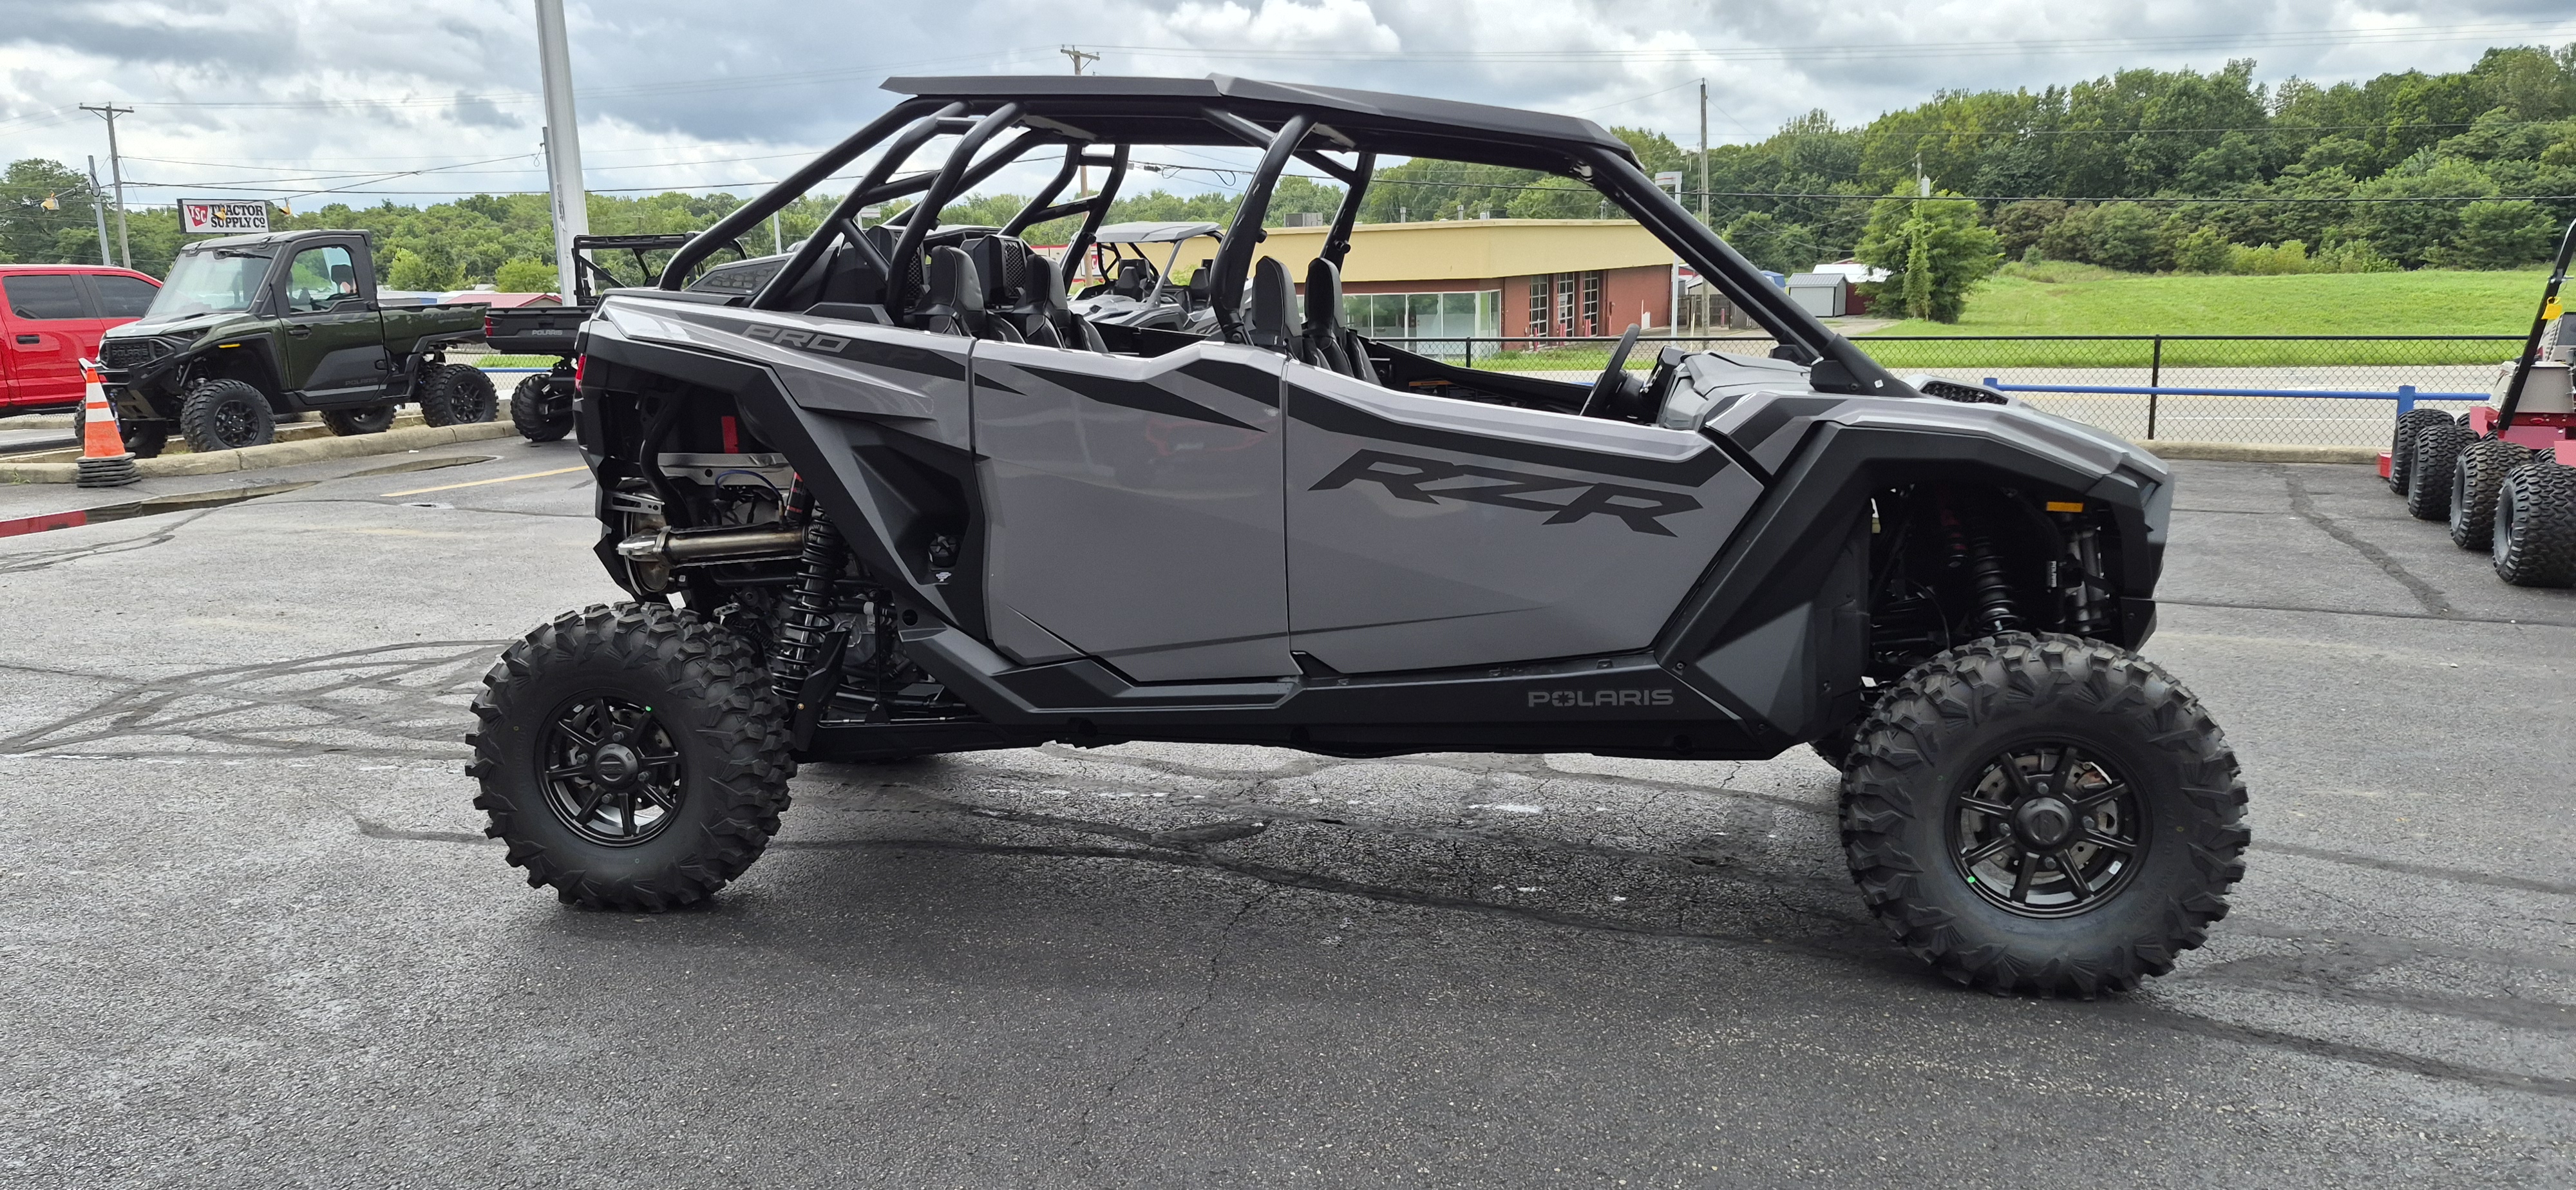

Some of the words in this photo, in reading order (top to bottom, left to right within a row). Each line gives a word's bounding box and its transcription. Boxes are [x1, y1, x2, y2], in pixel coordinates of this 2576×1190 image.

[189, 205, 206, 223] TSC
[211, 216, 252, 227] SUPPLY
[741, 324, 852, 353] PRO
[345, 377, 378, 386] POLARIS
[1307, 448, 1704, 538] RZR
[1528, 688, 1674, 708] POLARIS
